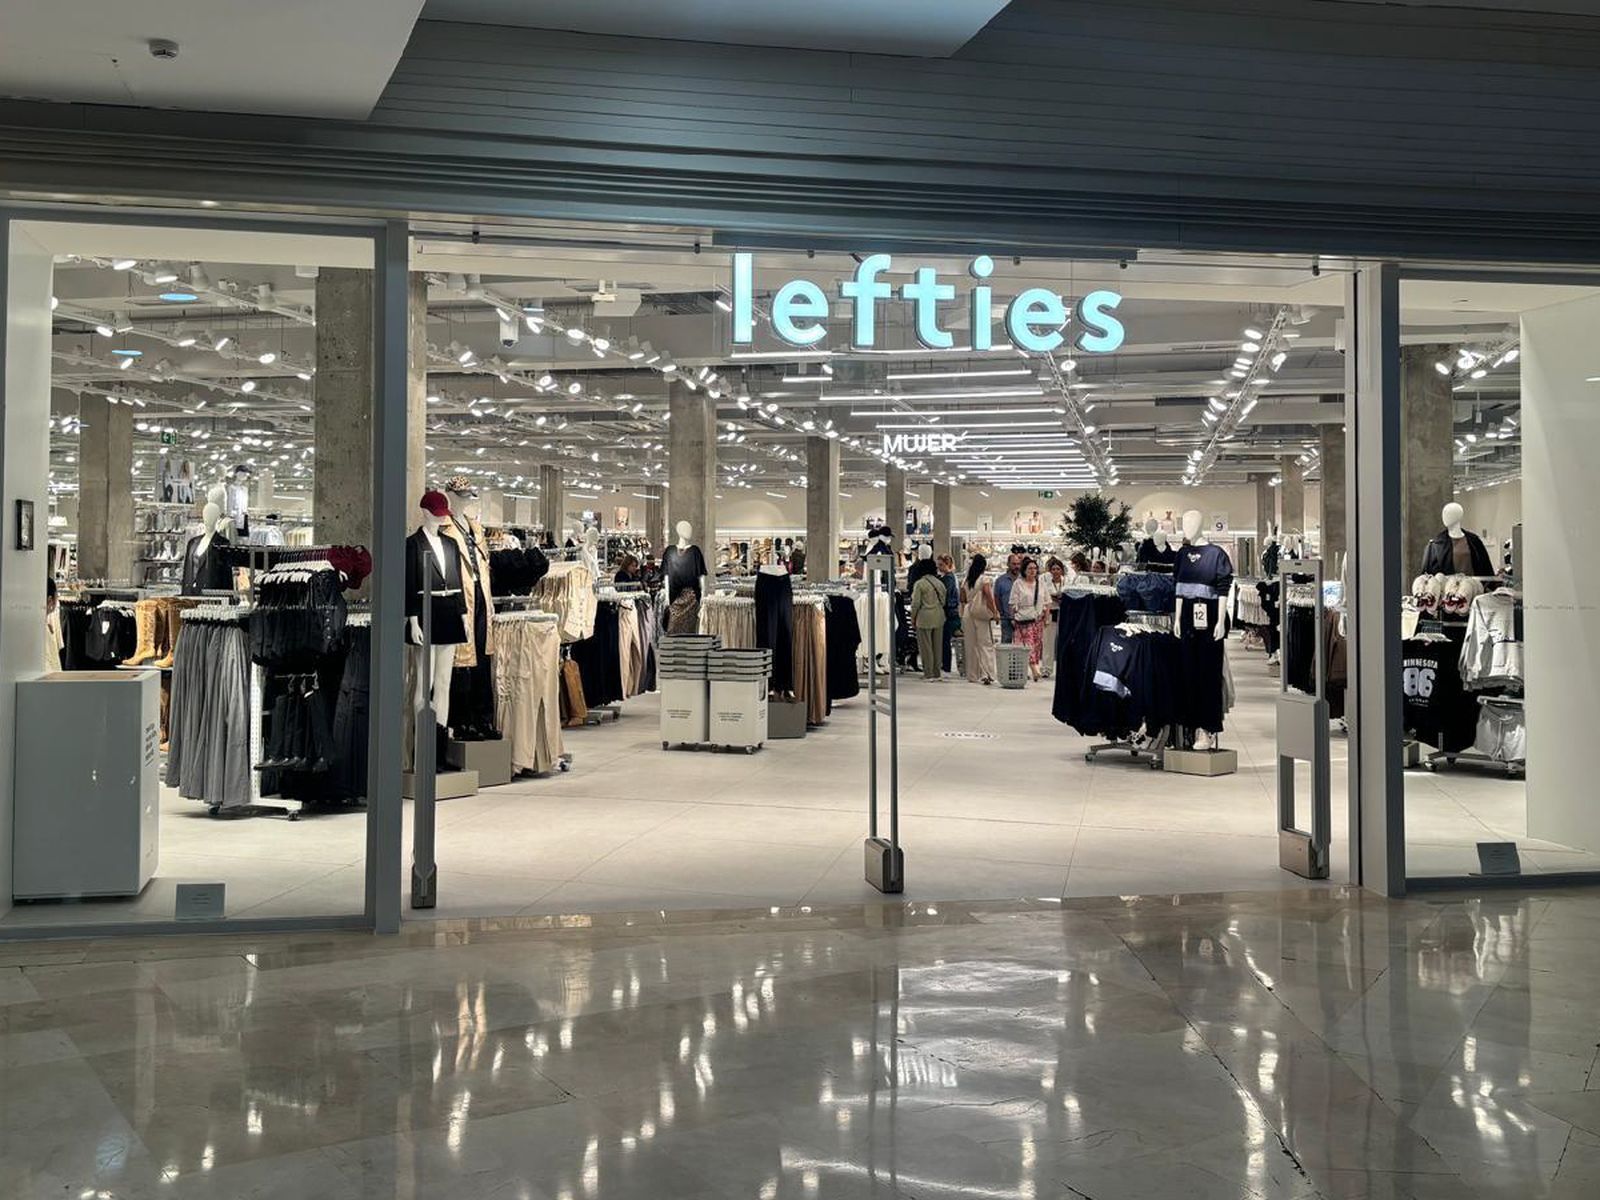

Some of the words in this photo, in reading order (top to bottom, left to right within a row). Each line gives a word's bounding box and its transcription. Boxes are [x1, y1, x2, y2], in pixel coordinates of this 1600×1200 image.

[731, 252, 1126, 353] lefties
[883, 433, 958, 453] MUJER
[1215, 522, 1223, 532] 9
[1195, 611, 1204, 620] 12
[1403, 667, 1436, 697] 86
